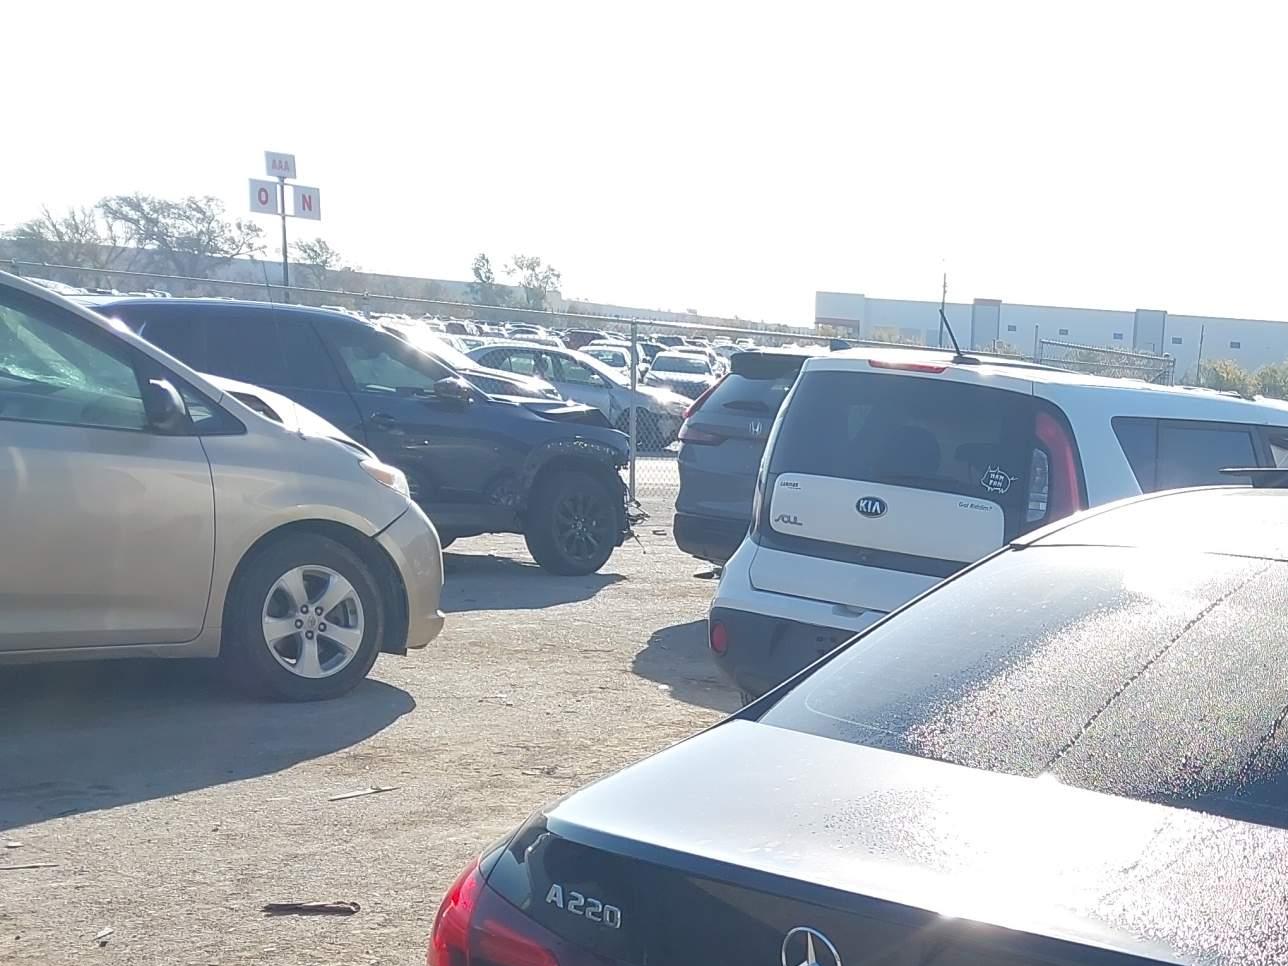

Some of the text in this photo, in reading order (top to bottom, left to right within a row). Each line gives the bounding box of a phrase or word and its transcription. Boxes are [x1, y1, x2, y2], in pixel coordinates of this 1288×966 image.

[258, 187, 313, 212] O N
[858, 500, 881, 514] KIA
[545, 883, 621, 929] A220
